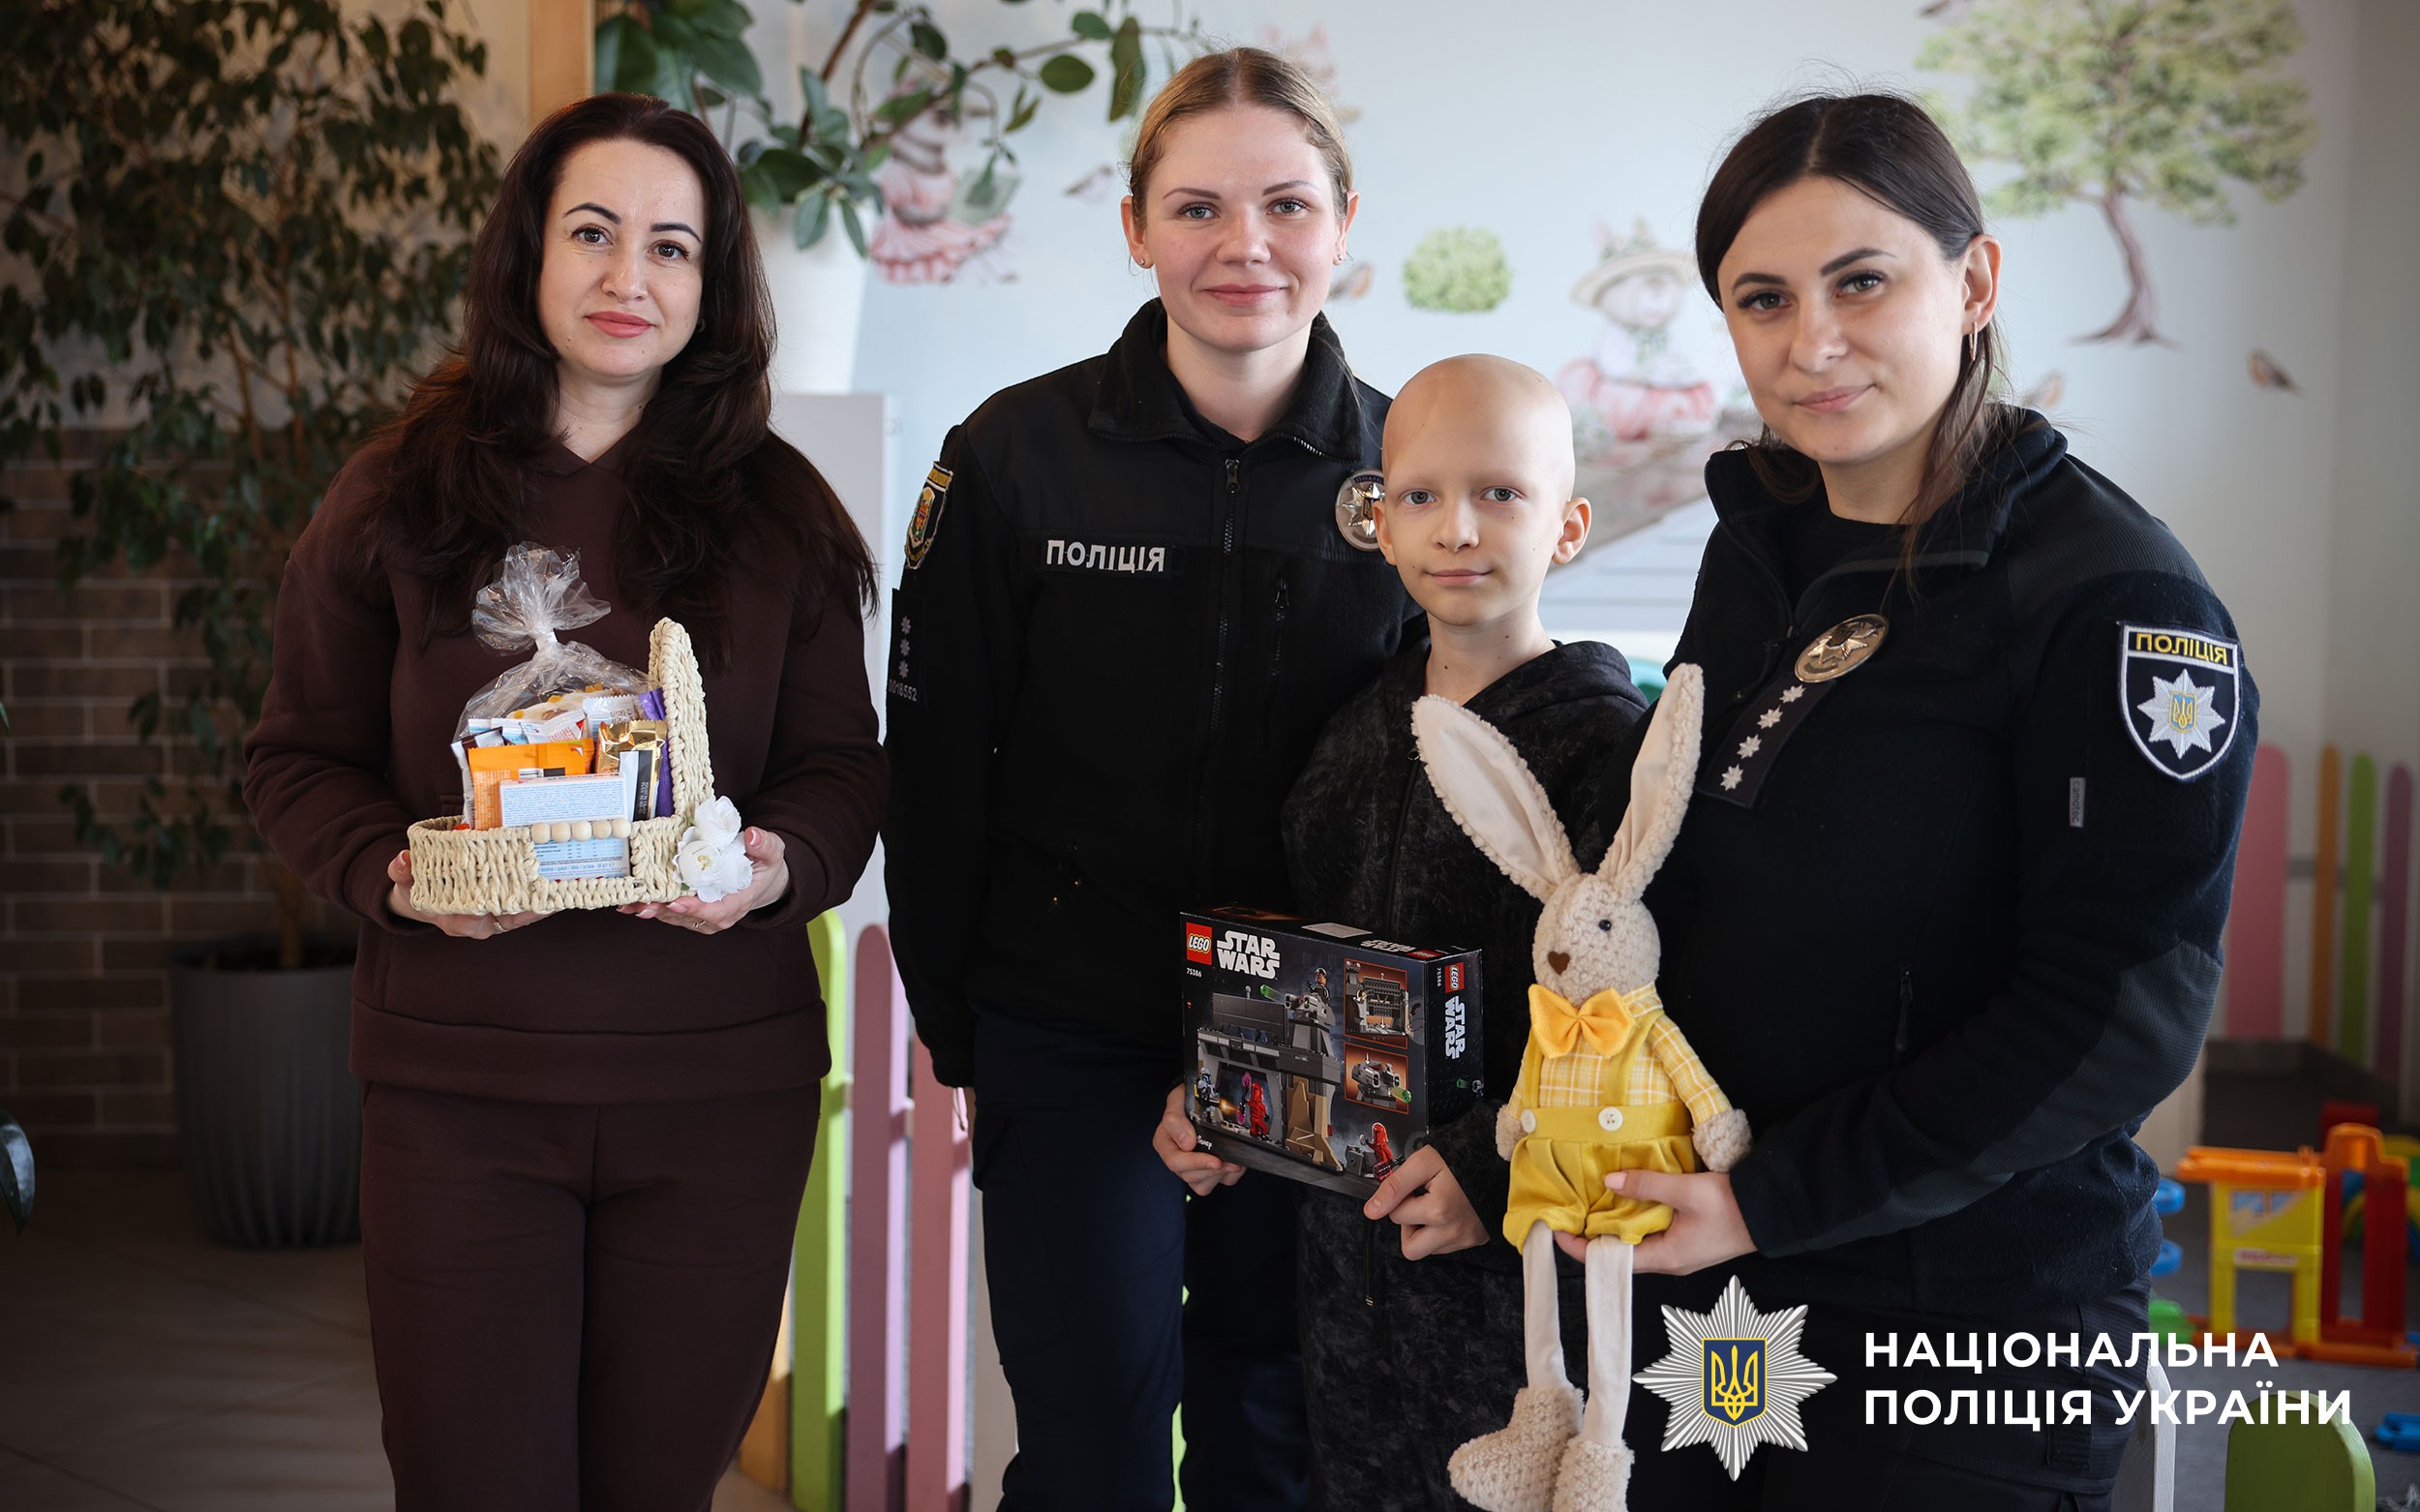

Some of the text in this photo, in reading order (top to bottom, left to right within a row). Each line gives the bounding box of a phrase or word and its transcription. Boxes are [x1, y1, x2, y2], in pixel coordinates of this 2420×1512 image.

[1045, 538, 1165, 574] ПОЛІЦІЯ
[2135, 632, 2227, 665] ПОЛІЦІЯ
[1188, 933, 1211, 953] LEGO
[1217, 930, 1280, 960] STAR
[1217, 948, 1280, 980] WARS
[1450, 965, 1459, 990] LEGO
[1445, 996, 1456, 1060] WARS
[1455, 995, 1466, 1058] STAR
